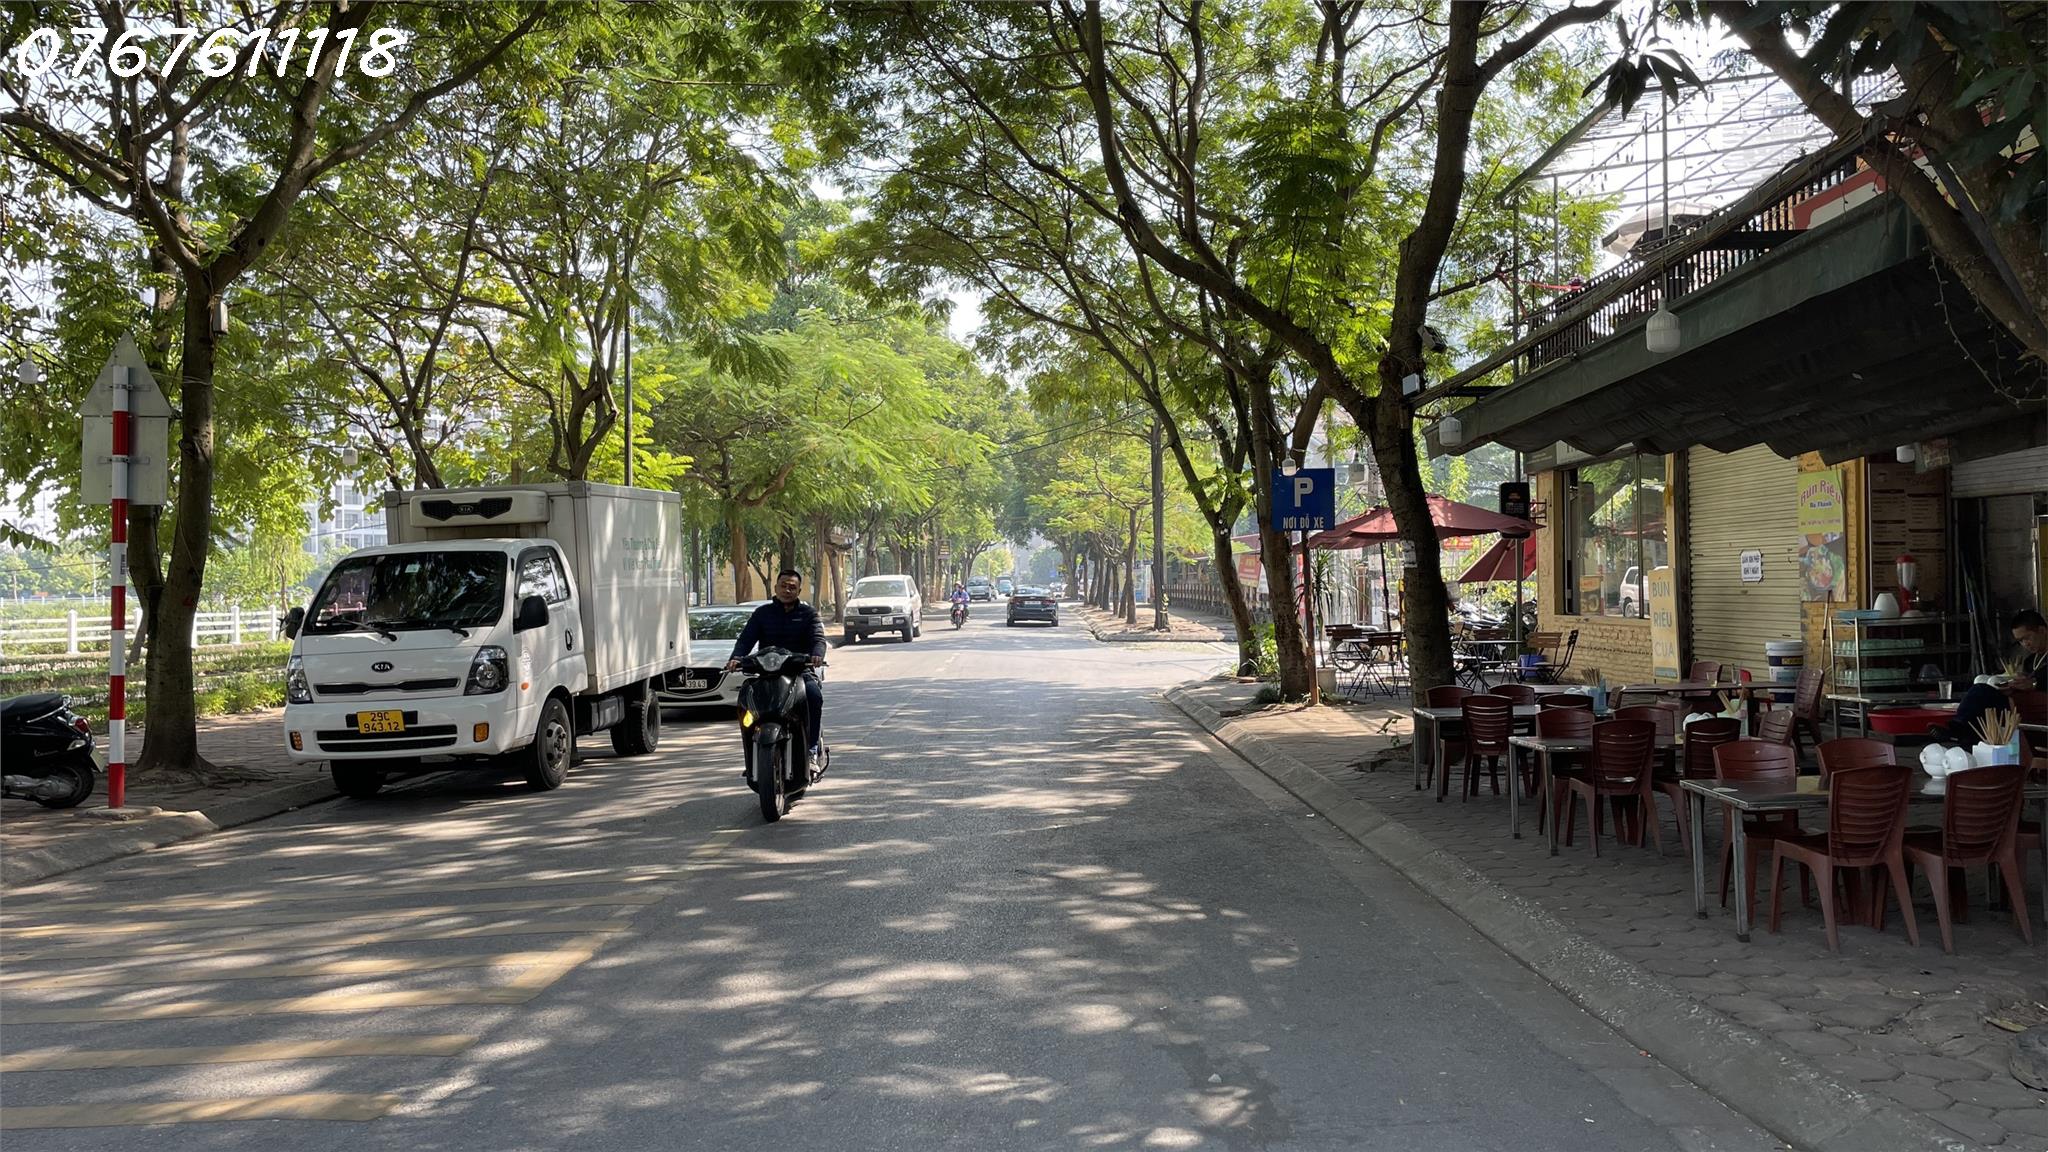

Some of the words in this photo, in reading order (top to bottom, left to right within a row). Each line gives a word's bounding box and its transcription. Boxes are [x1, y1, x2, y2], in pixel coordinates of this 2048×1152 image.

[1294, 477, 1313, 507] P
[1283, 516, 1297, 529] NƠI
[1313, 516, 1324, 529] XE
[1652, 576, 1670, 597] BÚN
[1655, 641, 1675, 657] CUA
[370, 711, 390, 722] 29C
[363, 721, 400, 733] 943.12
